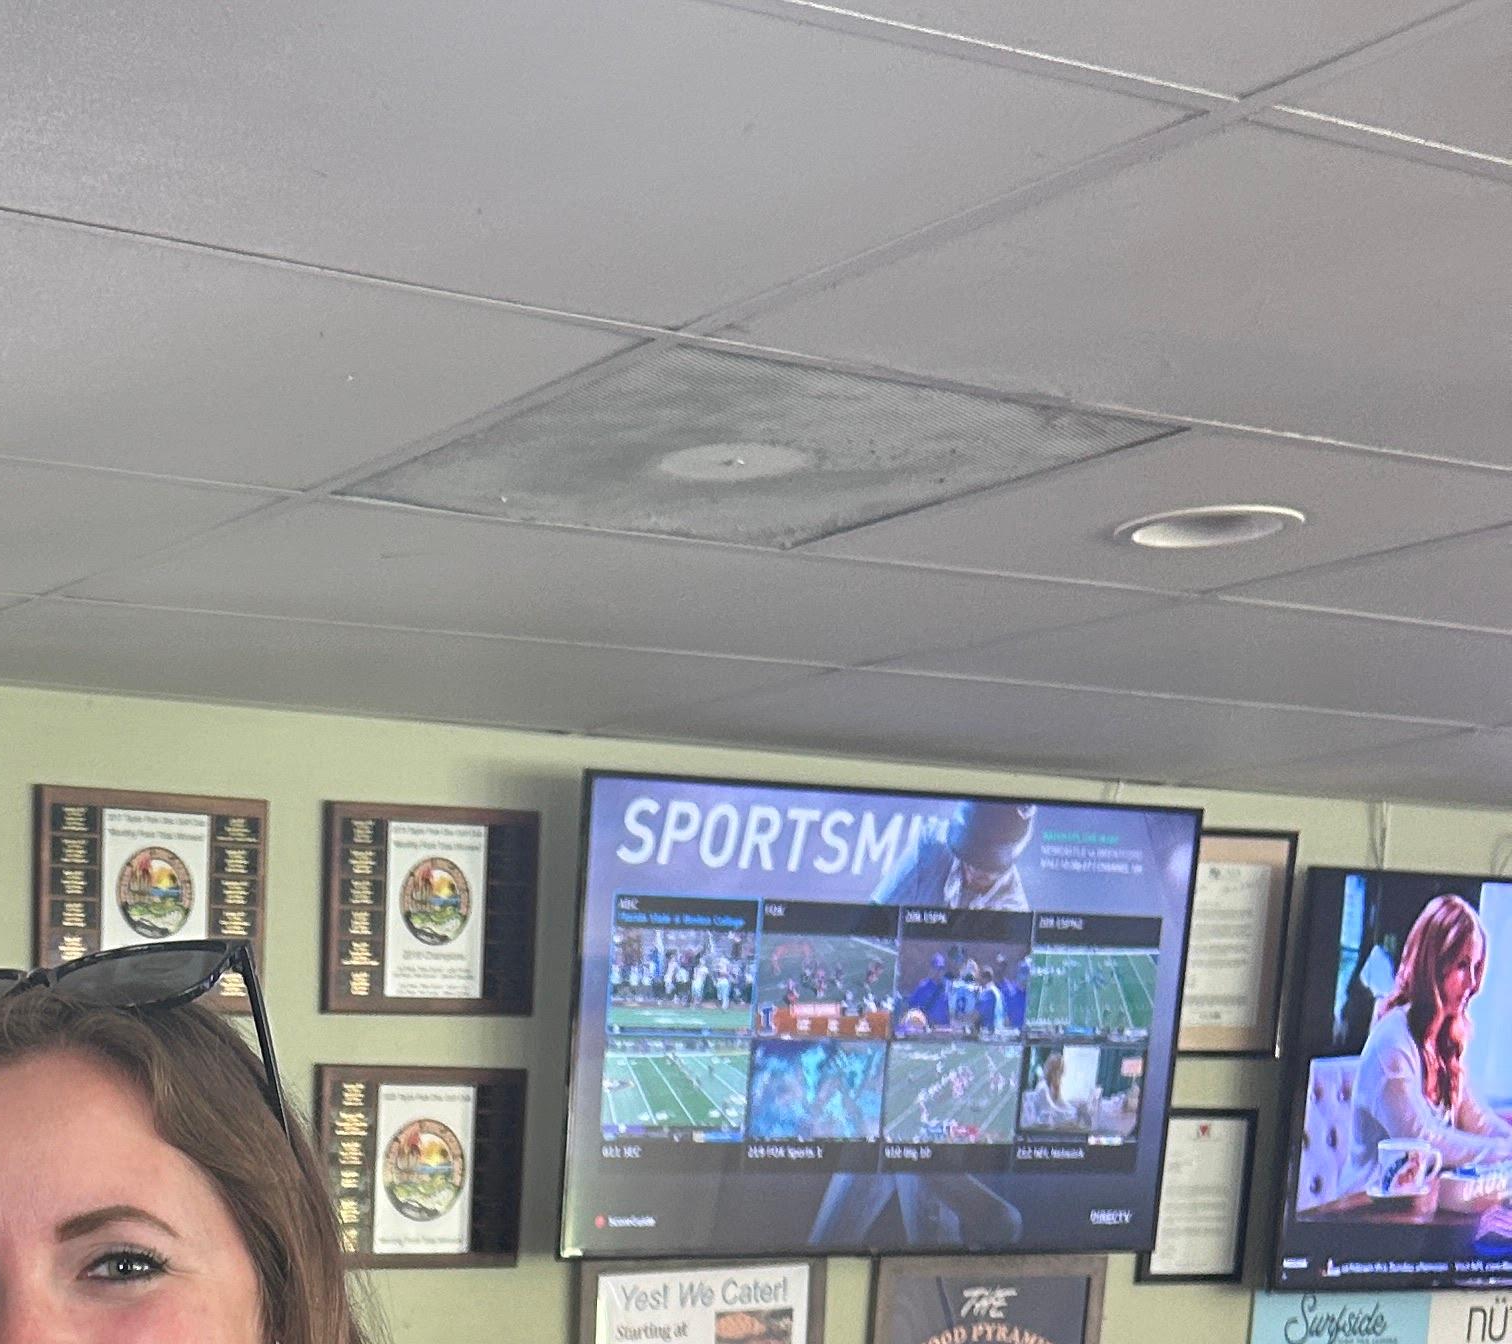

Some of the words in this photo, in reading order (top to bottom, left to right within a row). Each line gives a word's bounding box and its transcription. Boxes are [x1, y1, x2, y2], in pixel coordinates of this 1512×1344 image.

[620, 1284, 669, 1311] Yes!
[678, 1280, 715, 1309] We
[720, 1276, 789, 1305] Cater!
[960, 1287, 1018, 1319] THE
